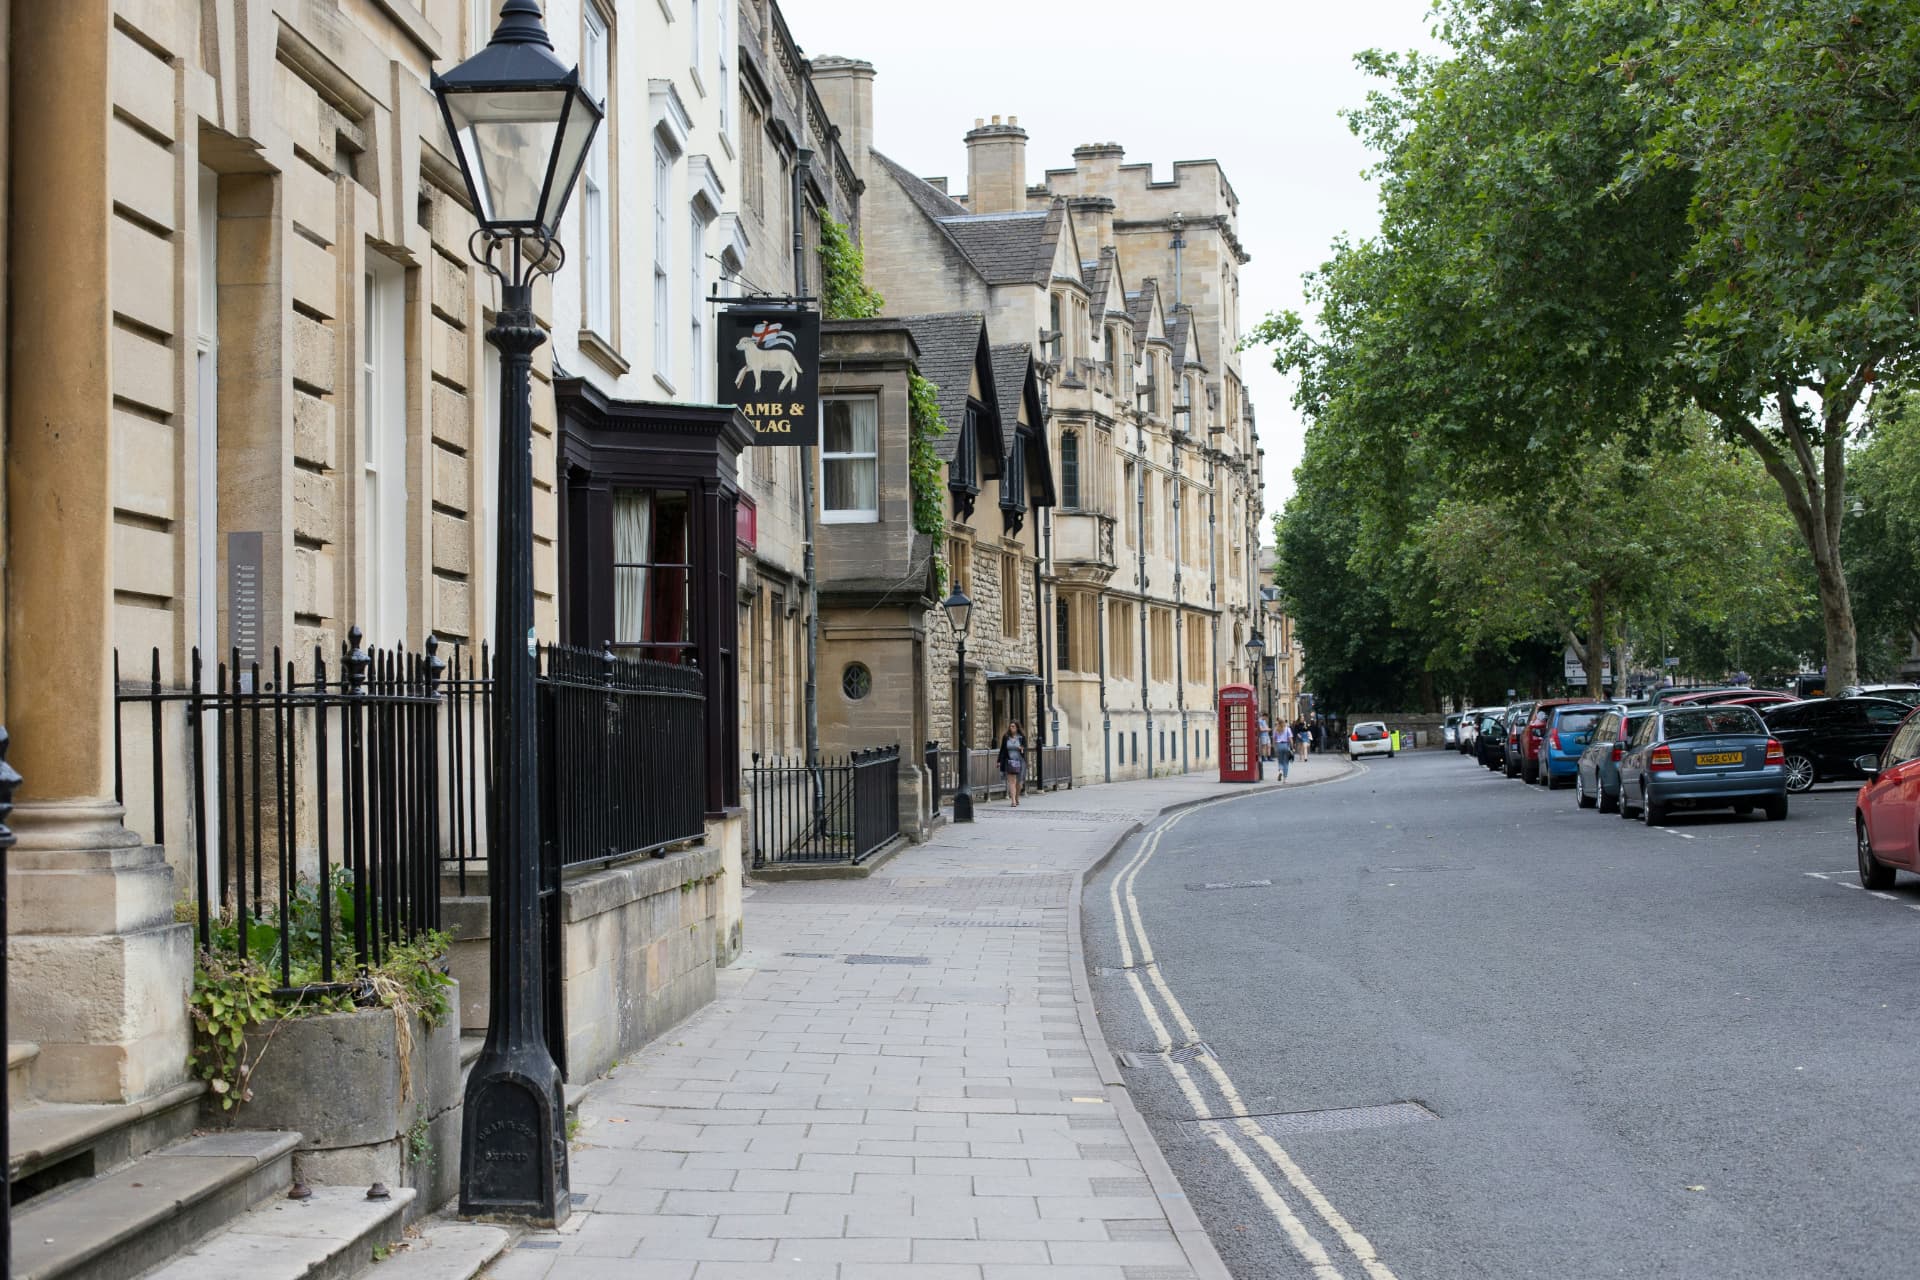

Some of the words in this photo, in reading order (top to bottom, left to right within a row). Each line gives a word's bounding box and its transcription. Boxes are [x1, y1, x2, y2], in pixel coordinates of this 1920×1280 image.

[743, 403, 783, 416] AMB
[789, 402, 805, 416] &
[752, 419, 791, 433] LAG
